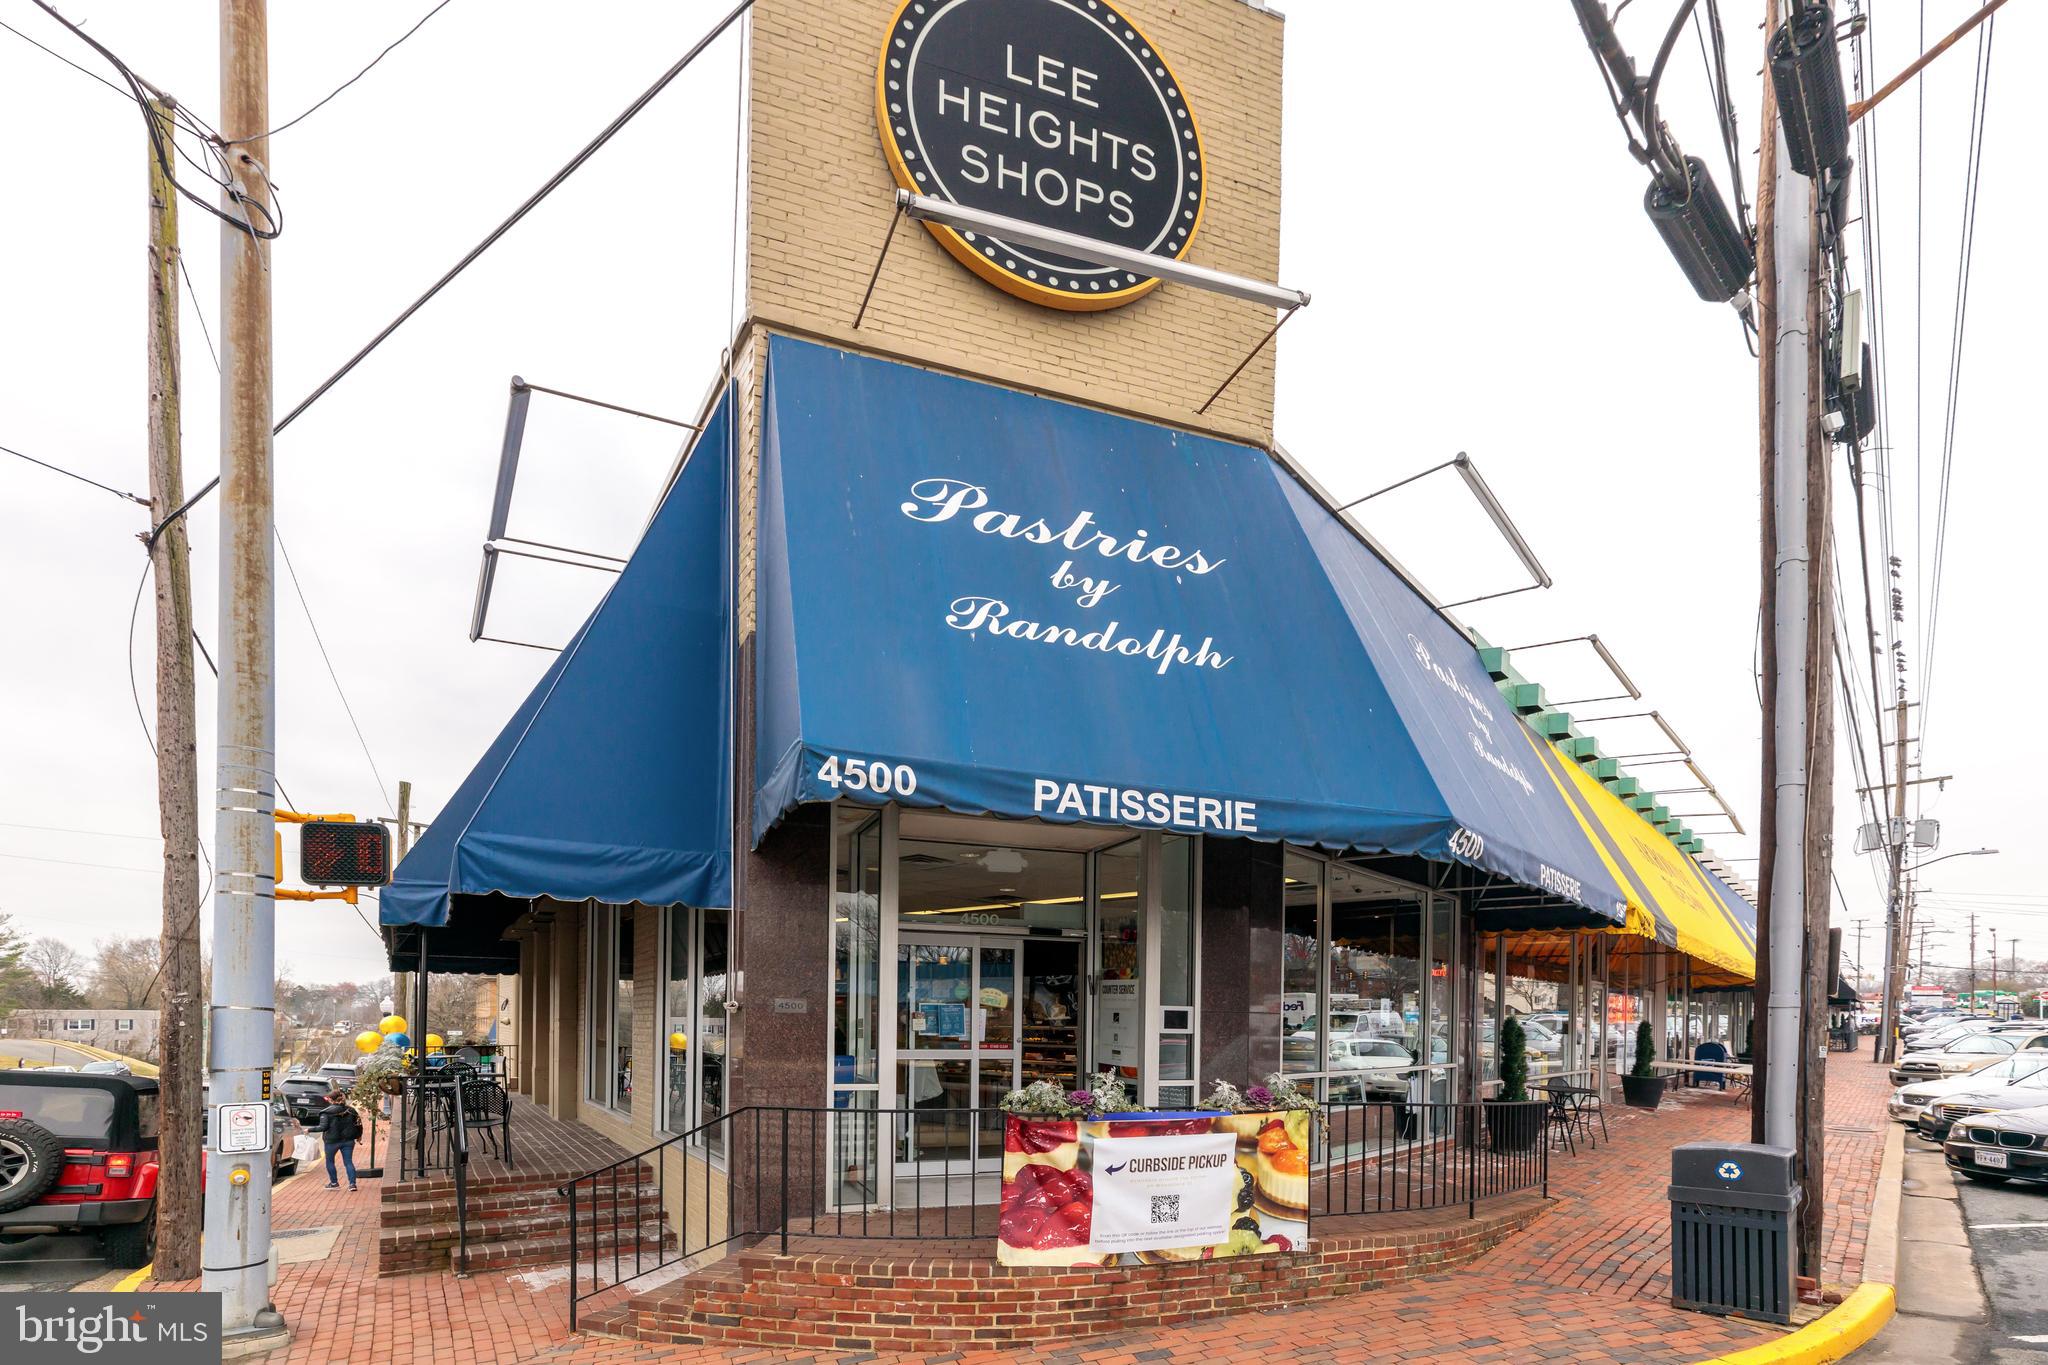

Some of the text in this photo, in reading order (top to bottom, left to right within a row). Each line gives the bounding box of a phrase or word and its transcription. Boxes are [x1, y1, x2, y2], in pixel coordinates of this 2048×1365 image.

[1007, 44, 1099, 108] LEE
[938, 78, 1157, 182] HEIGHTS
[960, 144, 1136, 229] SHOPS
[900, 478, 1227, 575] Pastries
[1050, 560, 1122, 608] by
[945, 596, 1235, 675] Randolph
[817, 756, 1258, 833] 4500 PATISSERIE
[1448, 828, 1582, 902] 4500 PATISSERIE
[960, 912, 1000, 926] 4500
[778, 1002, 804, 1010] 4500
[1129, 1153, 1227, 1173] CURBSIDE PICKUP
